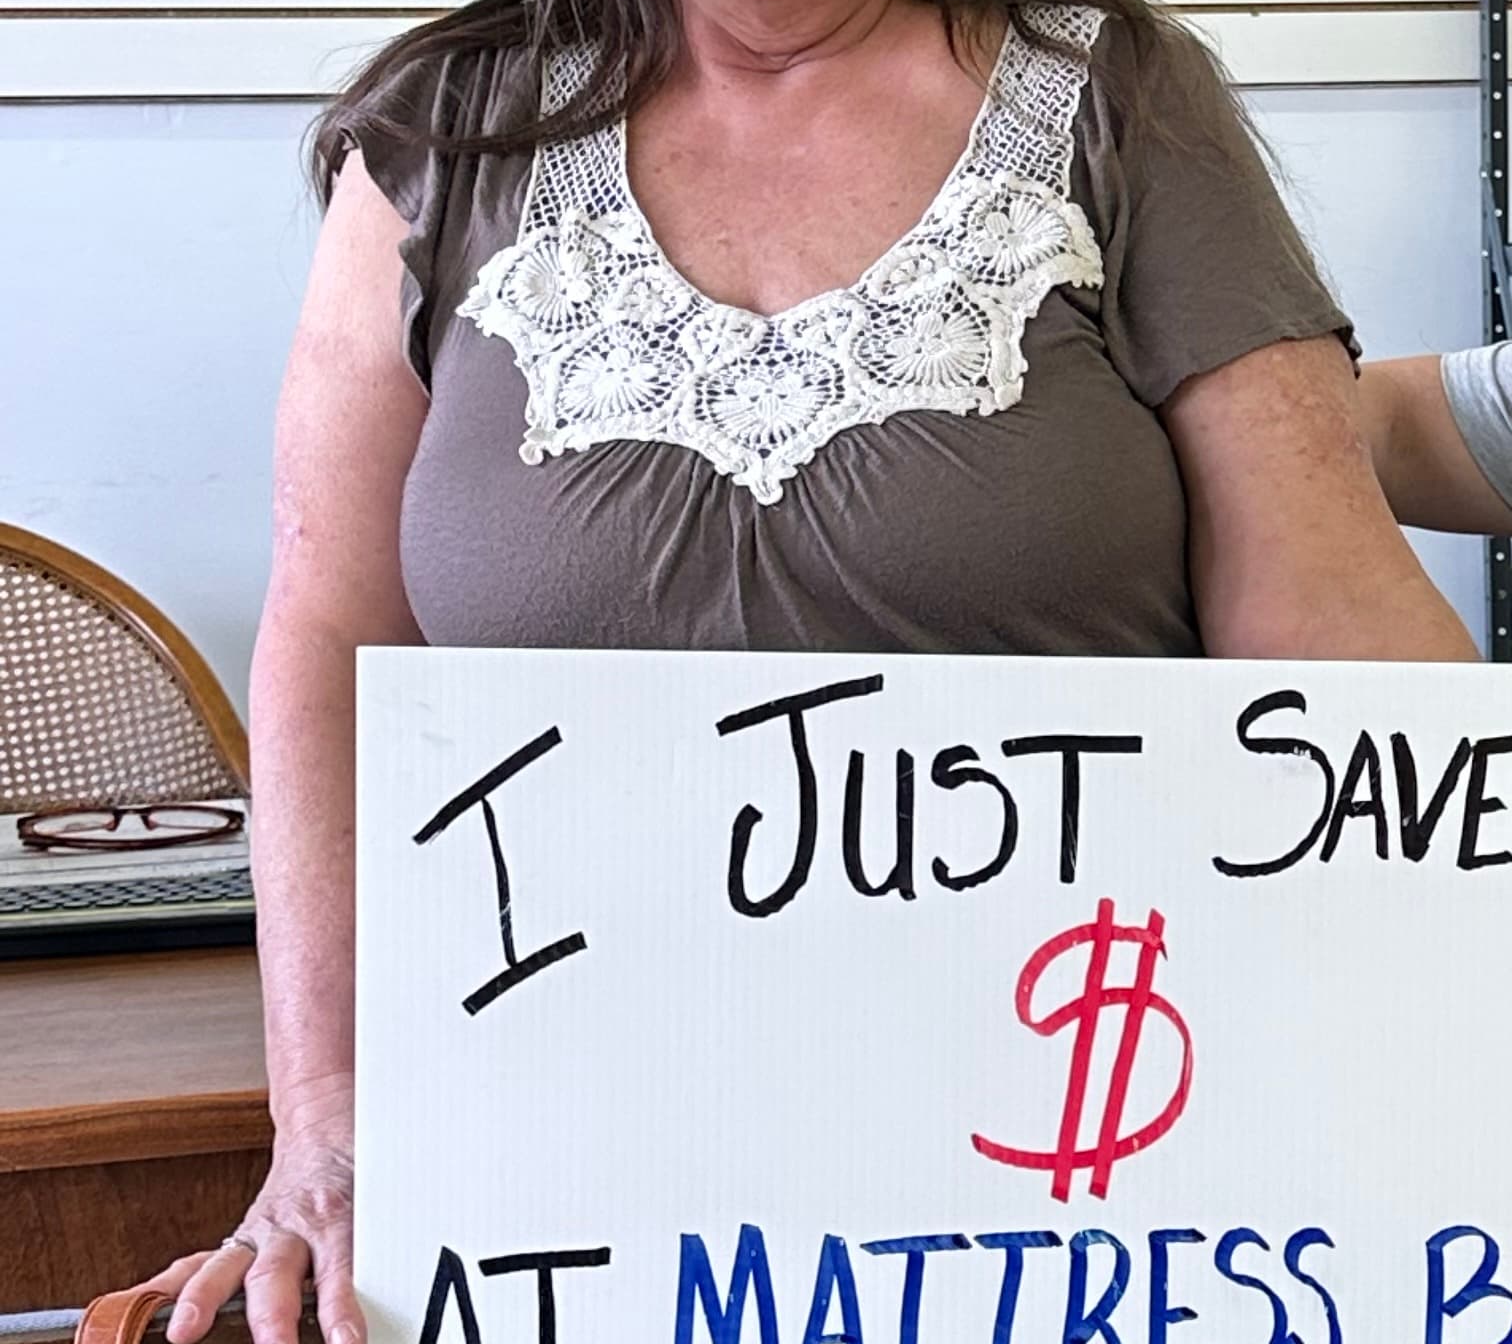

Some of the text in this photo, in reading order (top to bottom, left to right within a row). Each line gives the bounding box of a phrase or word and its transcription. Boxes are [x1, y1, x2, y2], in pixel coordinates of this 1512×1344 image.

[413, 726, 587, 1016] I
[715, 674, 1143, 918] JUST
[972, 898, 1193, 1204] $
